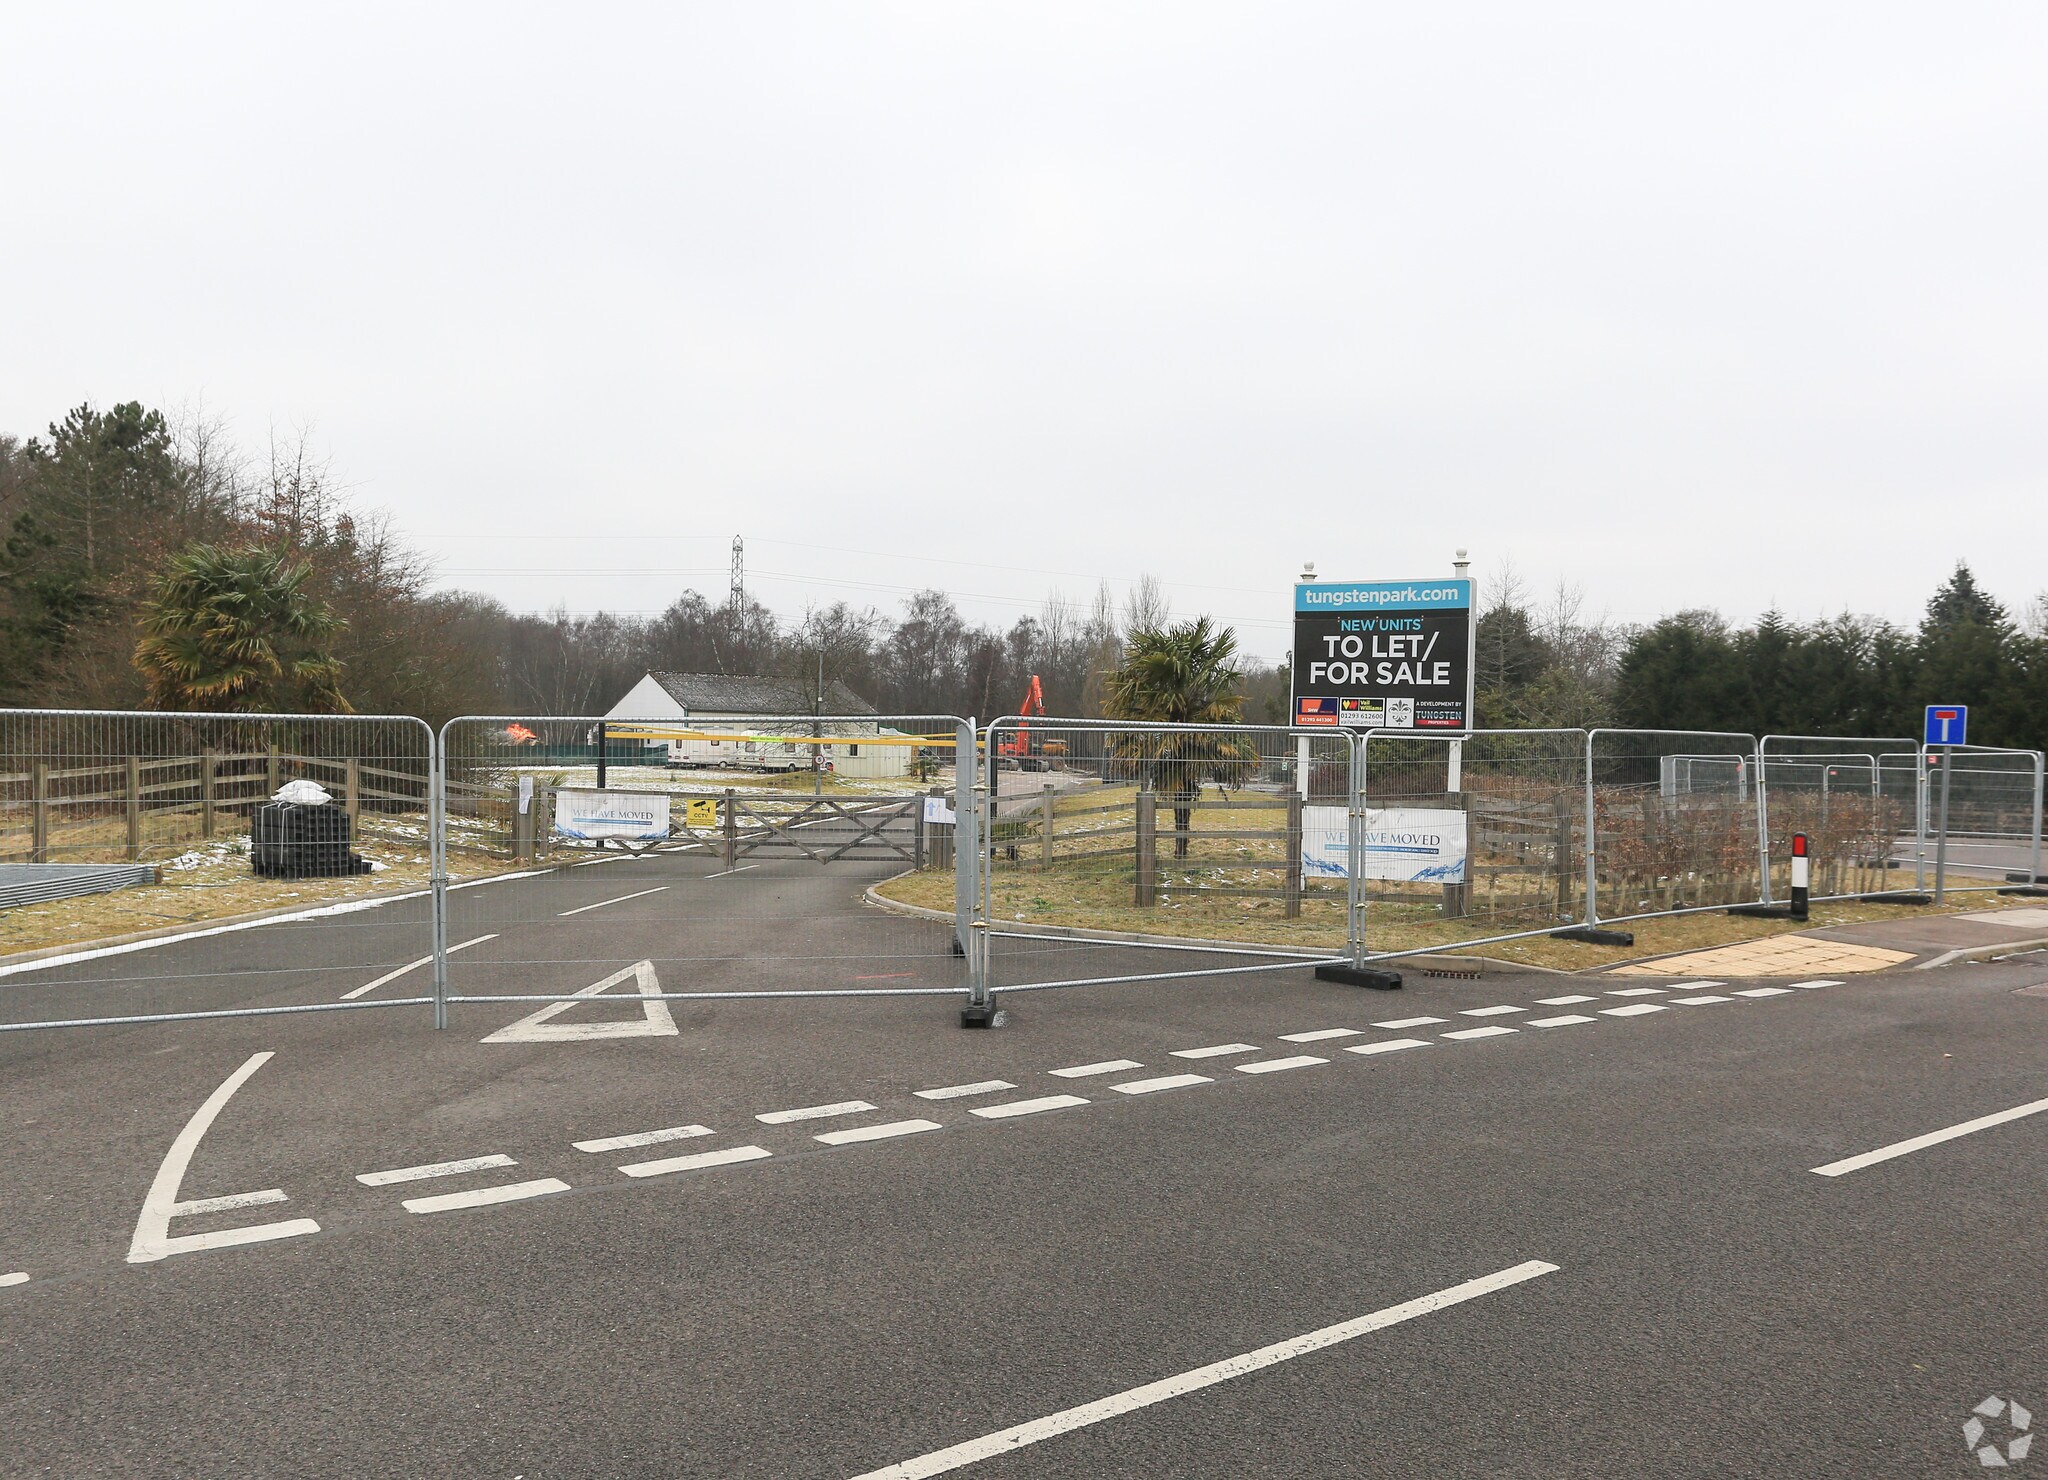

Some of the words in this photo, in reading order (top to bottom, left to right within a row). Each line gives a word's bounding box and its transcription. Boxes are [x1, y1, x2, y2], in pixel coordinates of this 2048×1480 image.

[1306, 587, 1458, 606] tungstenpark.com
[1341, 619, 1375, 632] NEW
[1379, 618, 1421, 631] UNITS
[1323, 635, 1363, 658] TO
[1372, 632, 1440, 661] LET/
[1310, 662, 1369, 685] FOR
[1376, 662, 1450, 685] SALE
[1416, 710, 1462, 719] TUNGSTEN
[572, 809, 588, 817] WE
[591, 809, 615, 818] HAVE
[619, 811, 653, 820] MOVED
[1325, 831, 1346, 842] WE
[1390, 833, 1440, 846] MOVED
